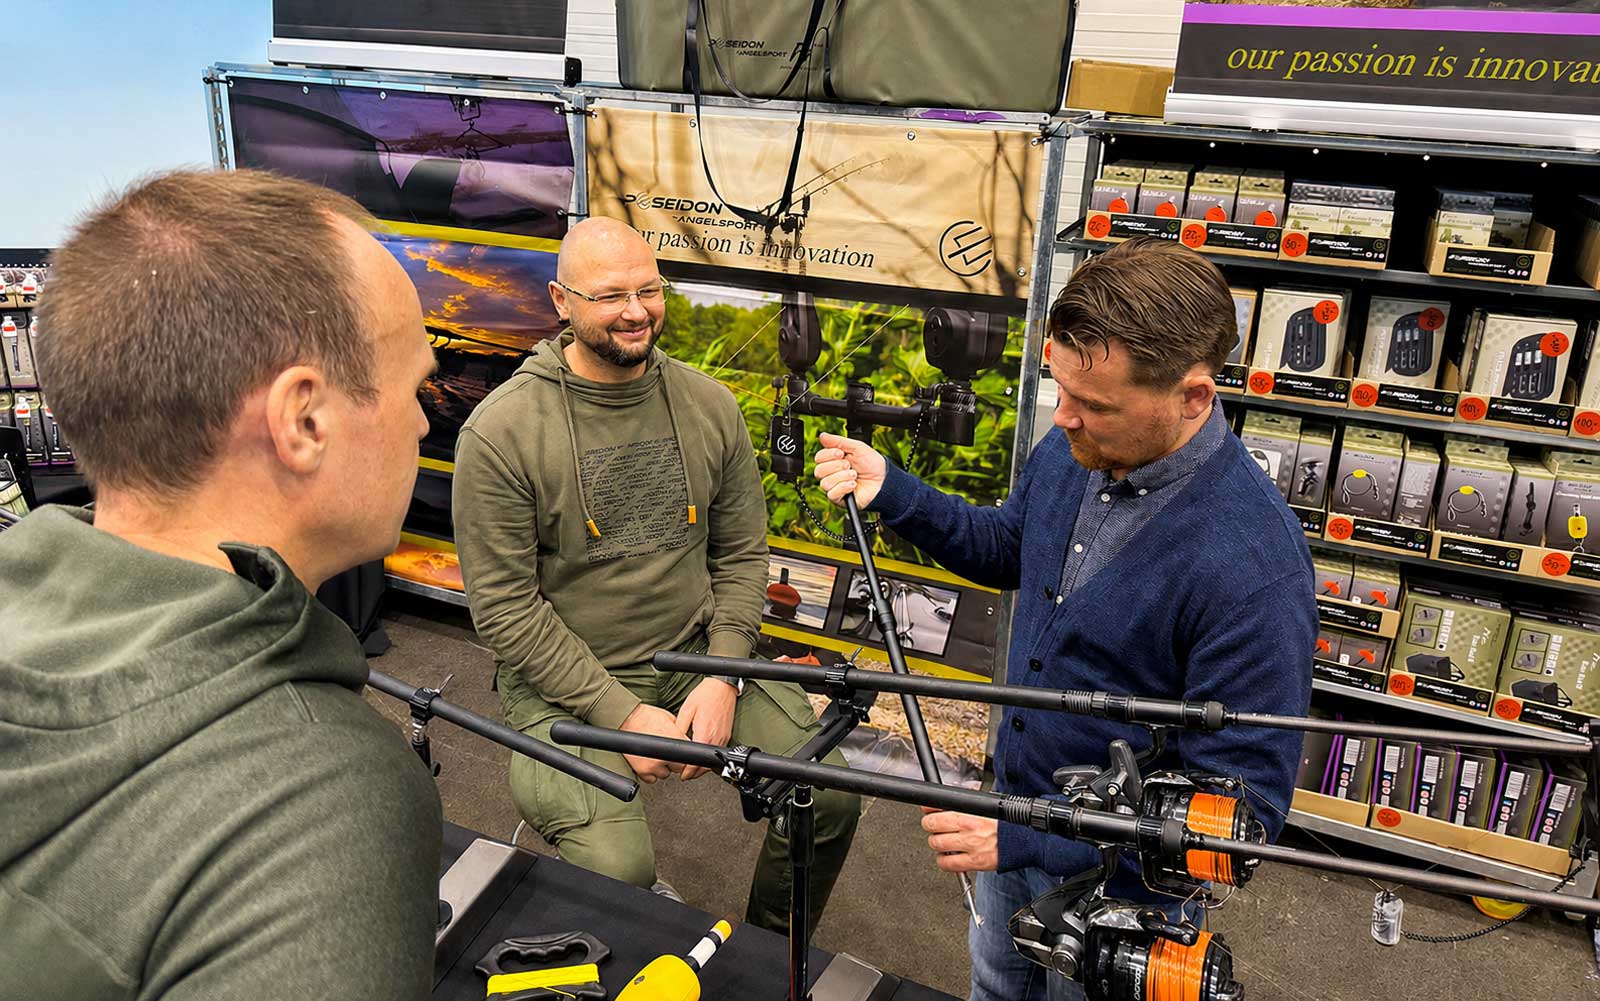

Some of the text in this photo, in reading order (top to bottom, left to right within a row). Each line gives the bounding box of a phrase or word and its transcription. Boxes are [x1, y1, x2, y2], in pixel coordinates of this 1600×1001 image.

[1227, 48, 1285, 70] our
[1282, 43, 1417, 80] passion
[1423, 46, 1459, 78] is
[657, 230, 732, 253] passion
[738, 234, 755, 256] is
[760, 240, 875, 268] innovation
